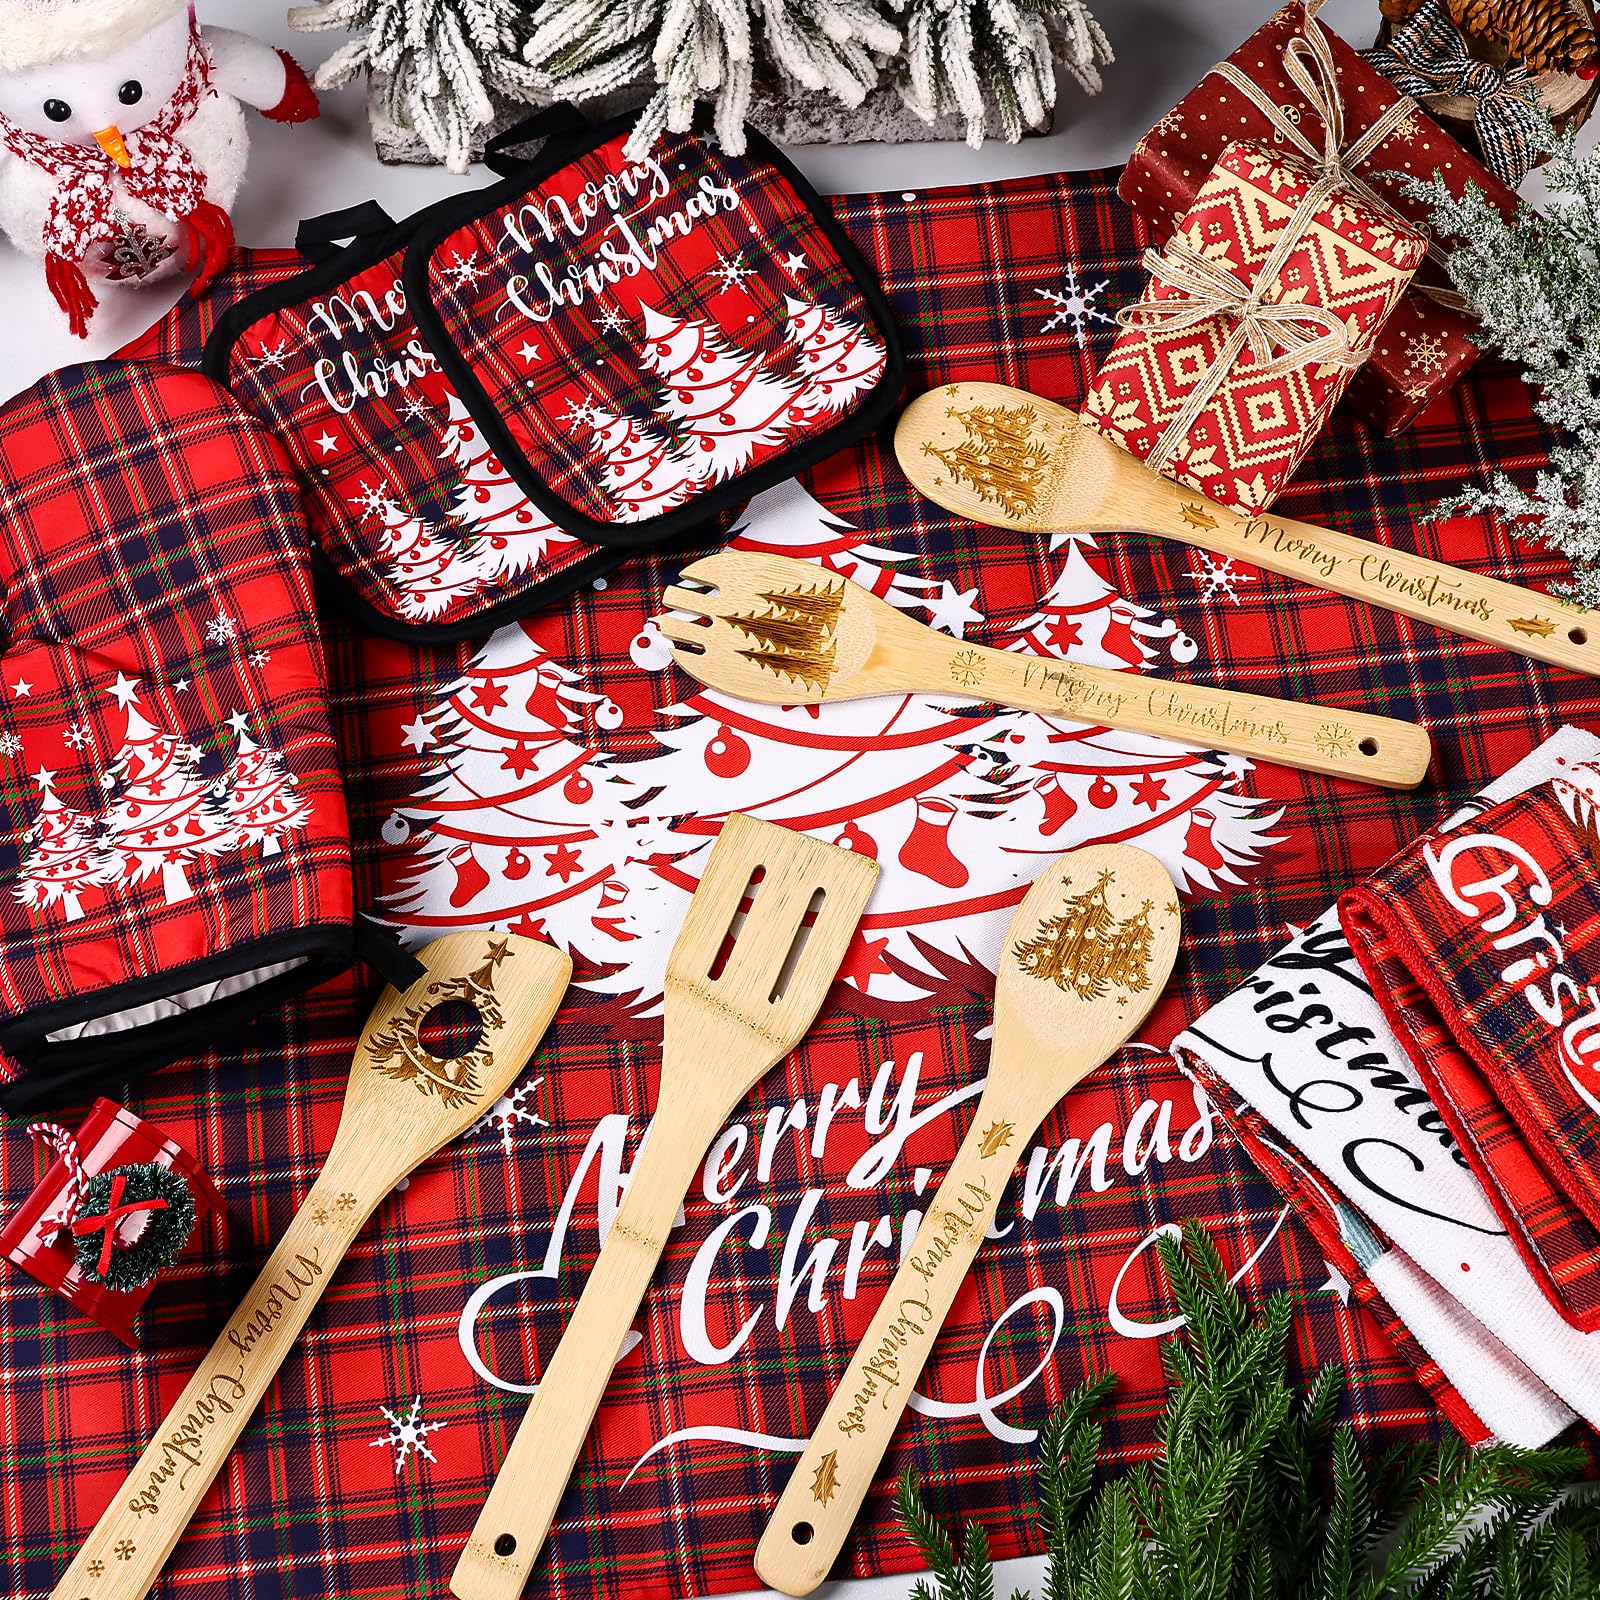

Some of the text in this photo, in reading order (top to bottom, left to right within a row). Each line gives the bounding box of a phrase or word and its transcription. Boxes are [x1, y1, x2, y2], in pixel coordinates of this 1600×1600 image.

[495, 175, 740, 322] Christmas
[497, 153, 670, 254] Merry
[300, 327, 443, 414] Chris
[1234, 518, 1494, 621] Merry Christmas
[1011, 660, 1291, 745] Merry Christmas
[838, 1175, 992, 1438] Merry Christmas
[129, 1246, 322, 1519] Merry Christmas
